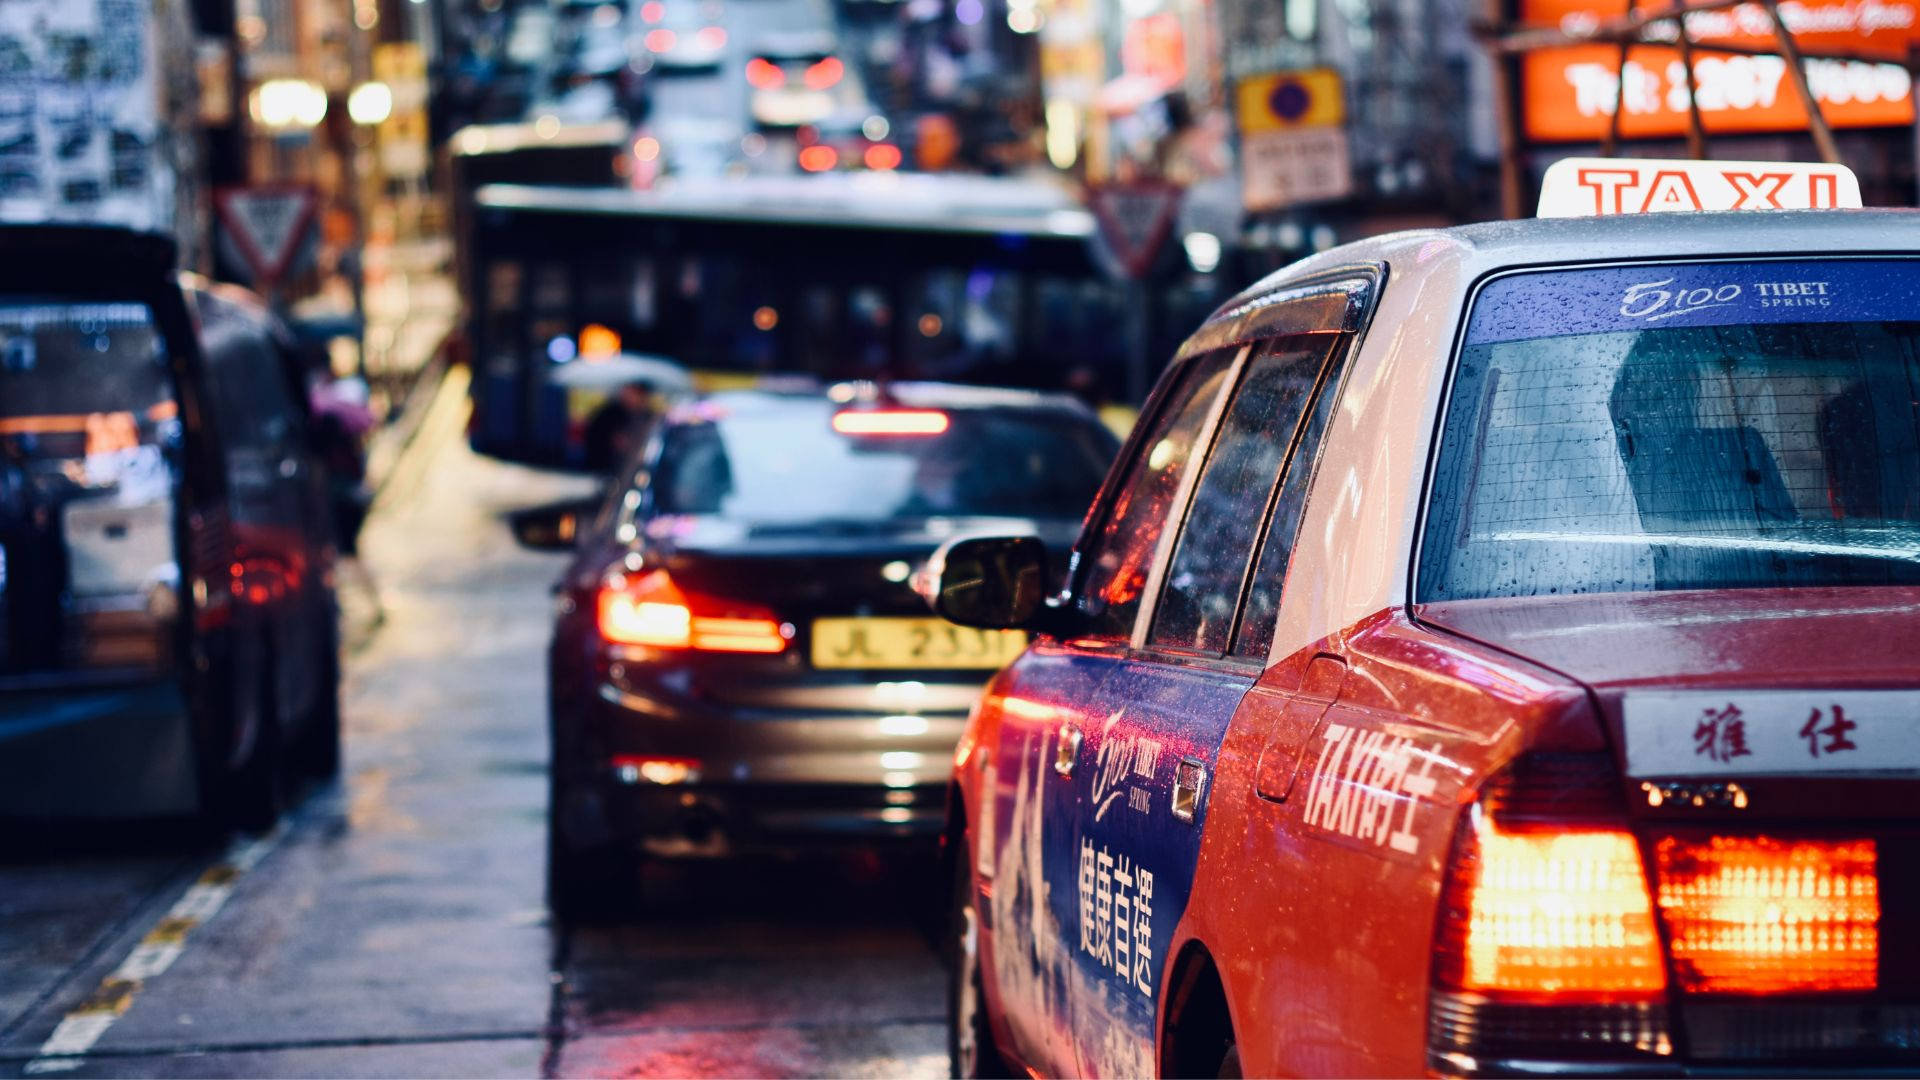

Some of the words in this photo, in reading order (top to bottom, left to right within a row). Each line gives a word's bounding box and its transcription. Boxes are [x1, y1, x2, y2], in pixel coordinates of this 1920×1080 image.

[1578, 168, 1838, 215] TAXI
[1619, 277, 1742, 321] 5100
[1754, 282, 1830, 296] TIBET
[1761, 297, 1831, 308] SPRING
[1693, 703, 1858, 763] 雅仕
[1078, 834, 1154, 998] 健康首選
